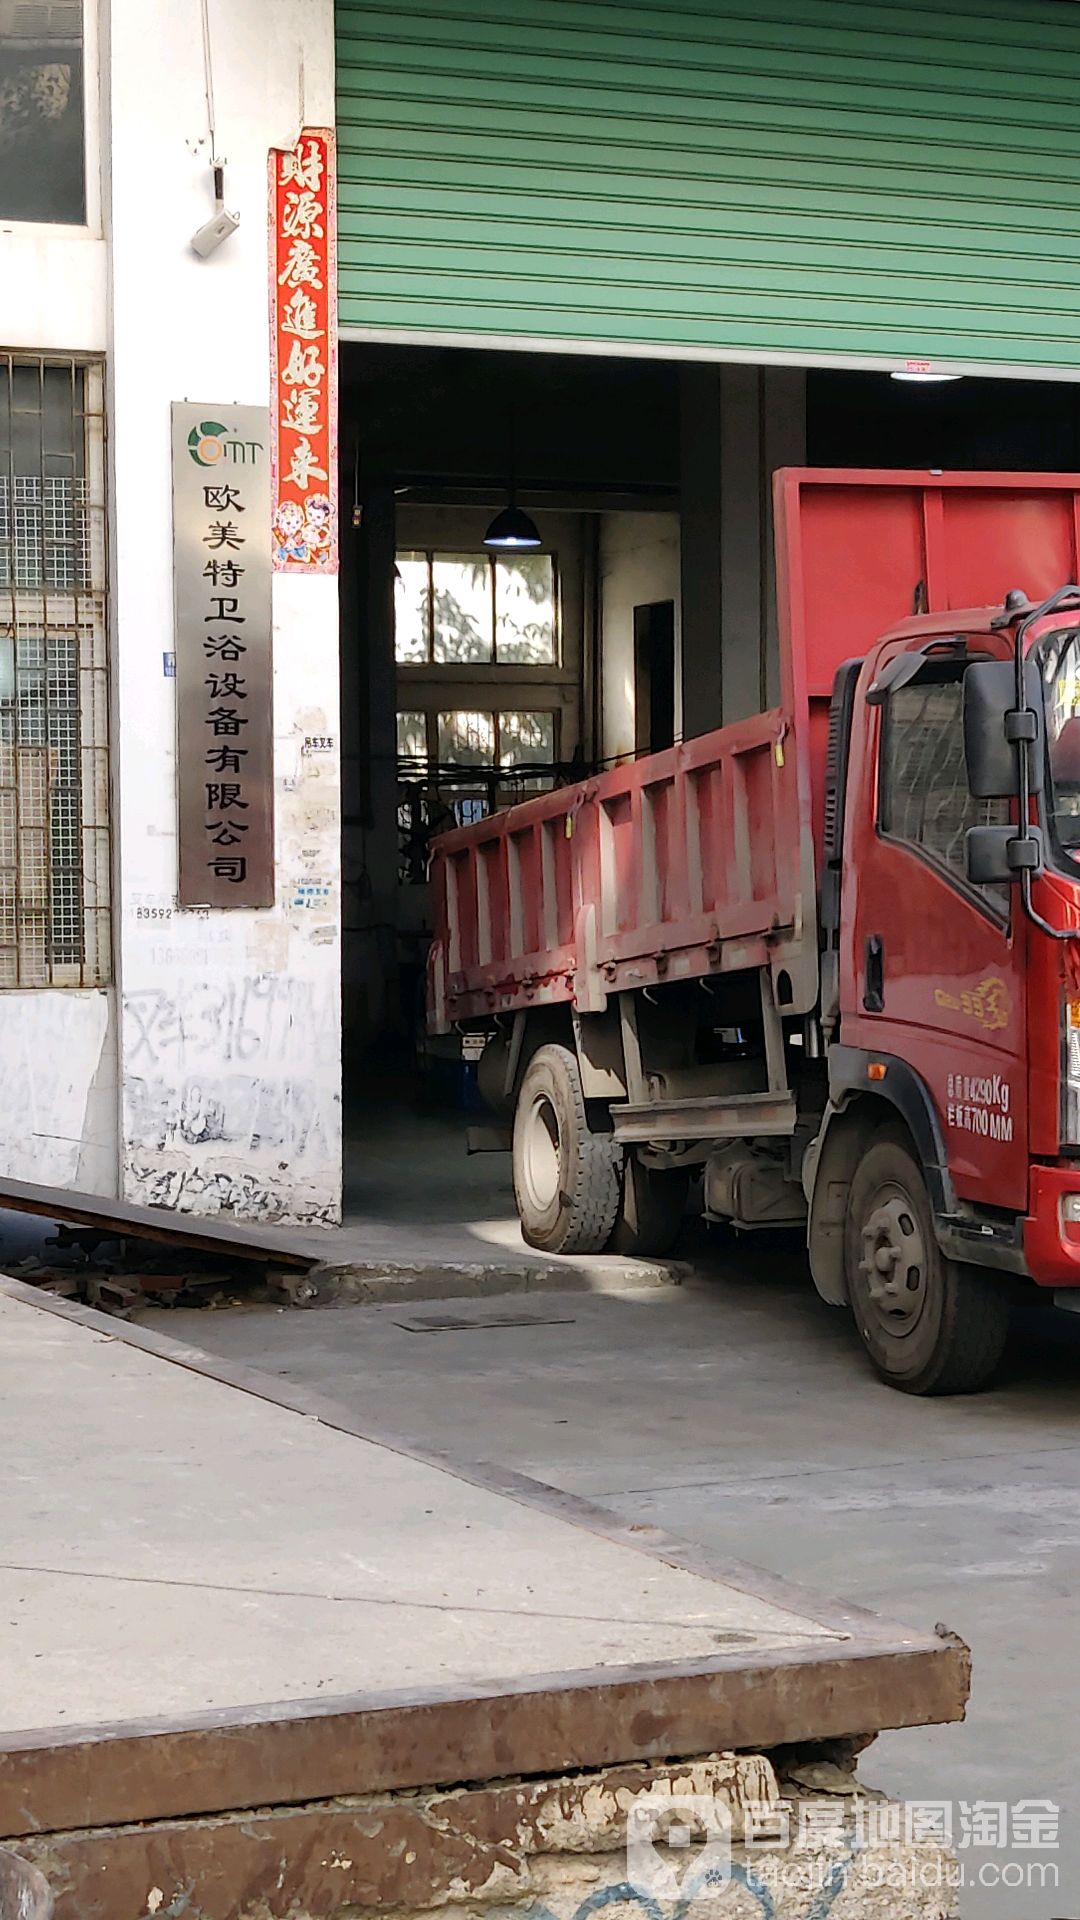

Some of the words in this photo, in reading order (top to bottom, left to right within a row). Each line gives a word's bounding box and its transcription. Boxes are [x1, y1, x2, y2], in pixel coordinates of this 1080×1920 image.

[202, 485, 249, 883] 欧美特卫浴设备有限公司
